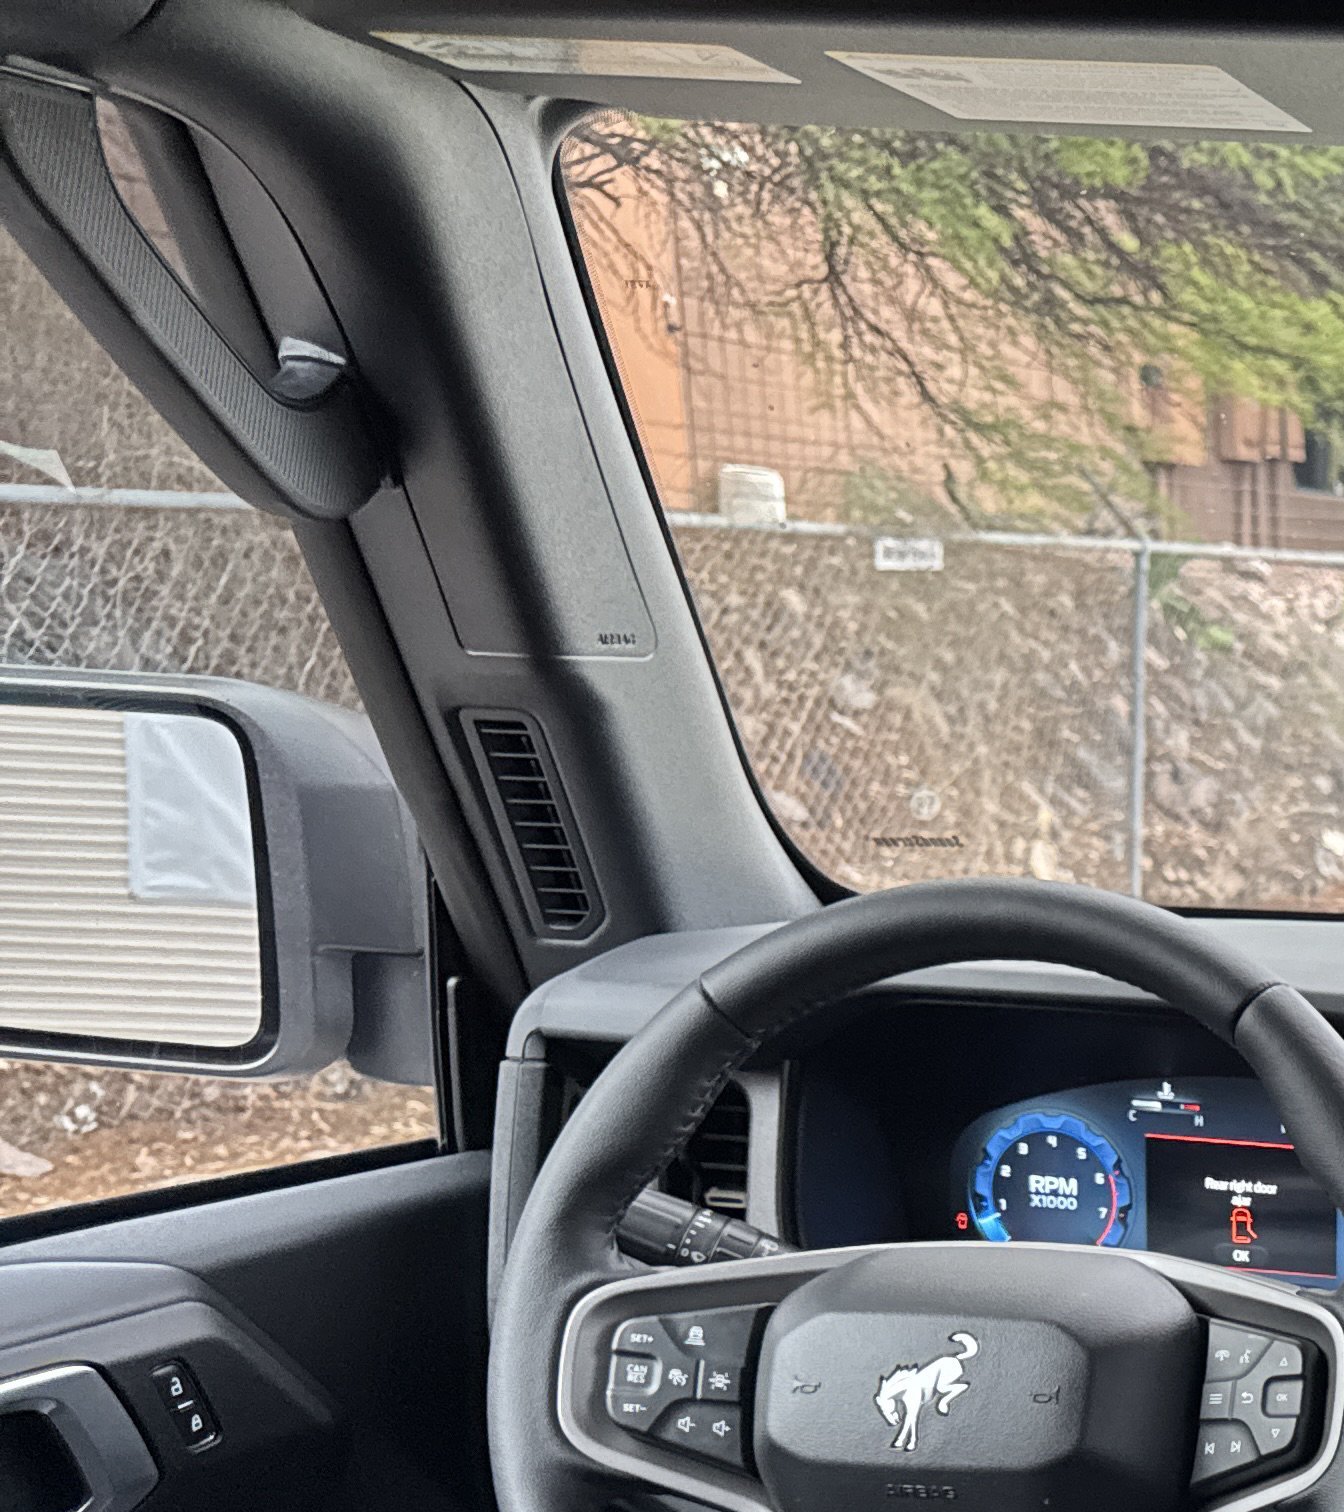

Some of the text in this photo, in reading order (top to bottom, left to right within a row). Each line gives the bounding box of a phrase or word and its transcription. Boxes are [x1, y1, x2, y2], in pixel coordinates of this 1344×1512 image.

[1194, 1114, 1204, 1127] H
[1047, 1135, 1058, 1148] 4
[1076, 1147, 1087, 1160] 5
[1000, 1164, 1012, 1178] 2
[1028, 1173, 1079, 1197] RPM
[1029, 1193, 1079, 1211] X1000
[1098, 1207, 1108, 1219] 7
[1232, 1249, 1251, 1263] OK
[626, 1364, 648, 1374] CAN
[626, 1373, 646, 1384] RES
[1275, 1392, 1288, 1402] OK
